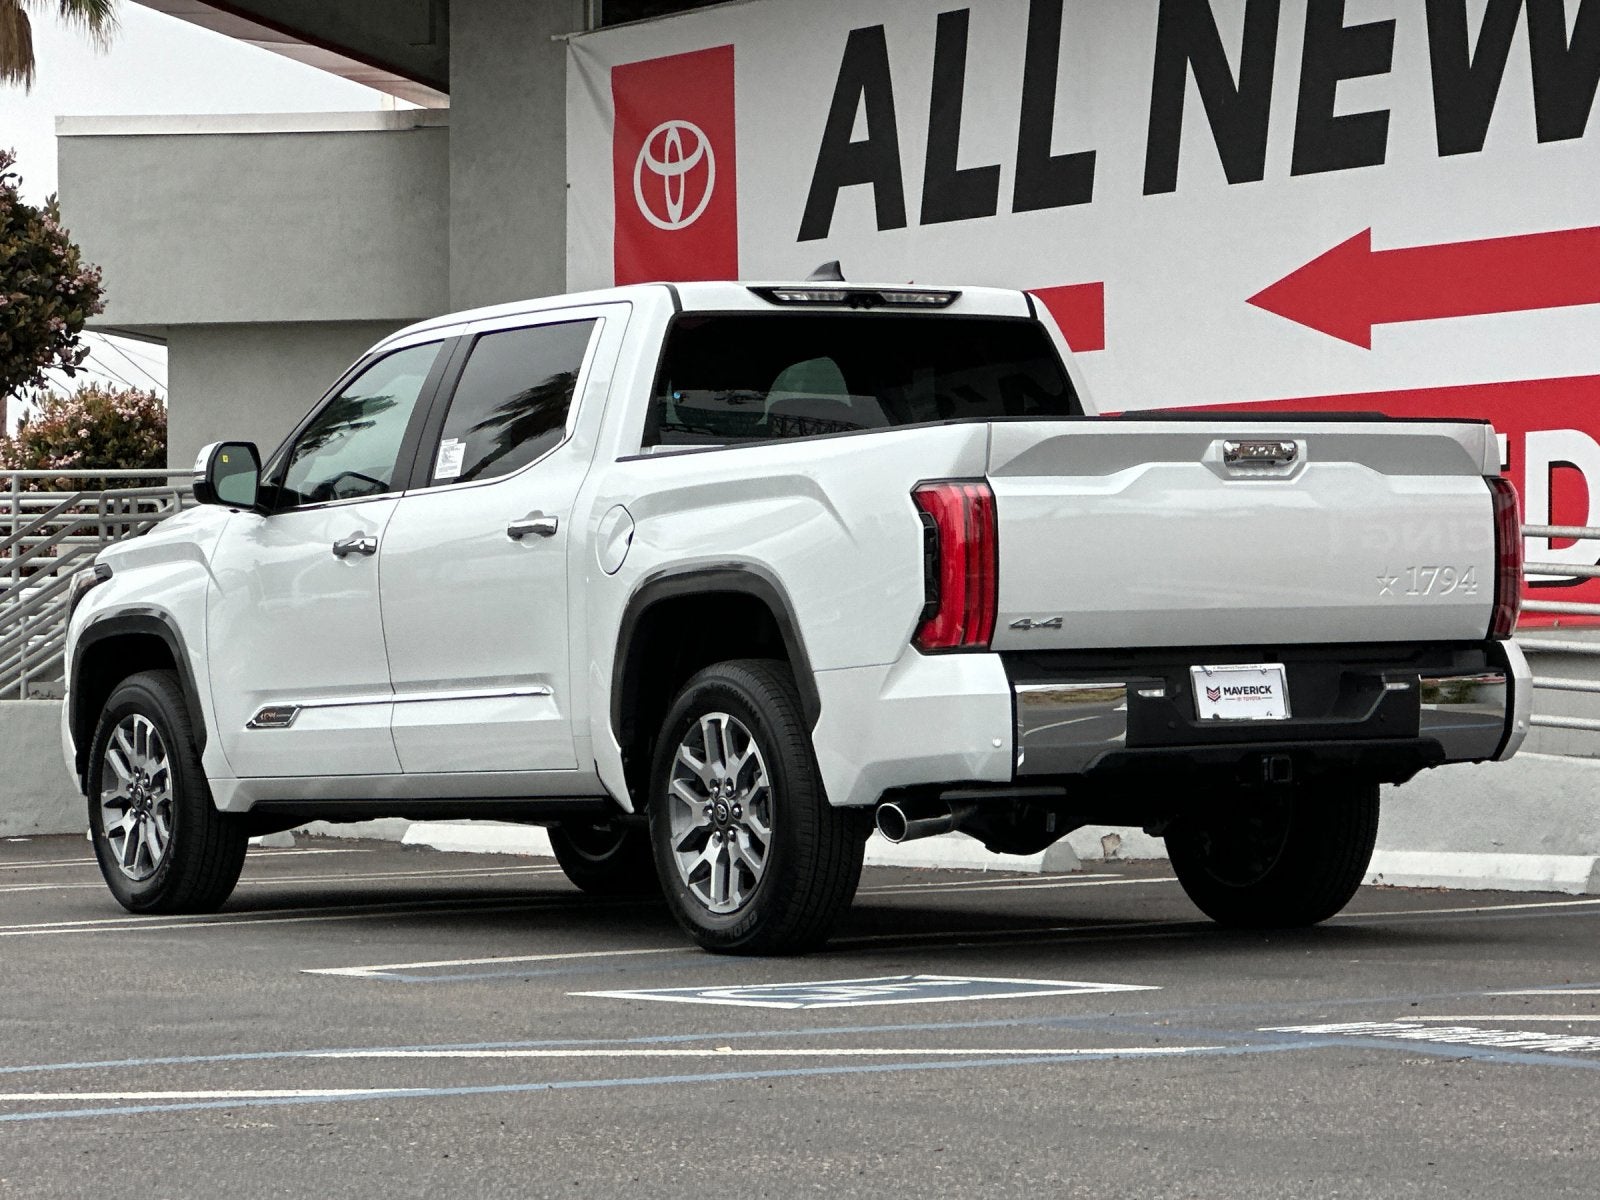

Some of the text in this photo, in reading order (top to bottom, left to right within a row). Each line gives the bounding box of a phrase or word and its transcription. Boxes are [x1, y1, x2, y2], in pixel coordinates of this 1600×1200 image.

[797, 0, 1600, 242] ALL NEW
[1406, 566, 1478, 596] 1794
[1223, 685, 1272, 695] MAVERICK
